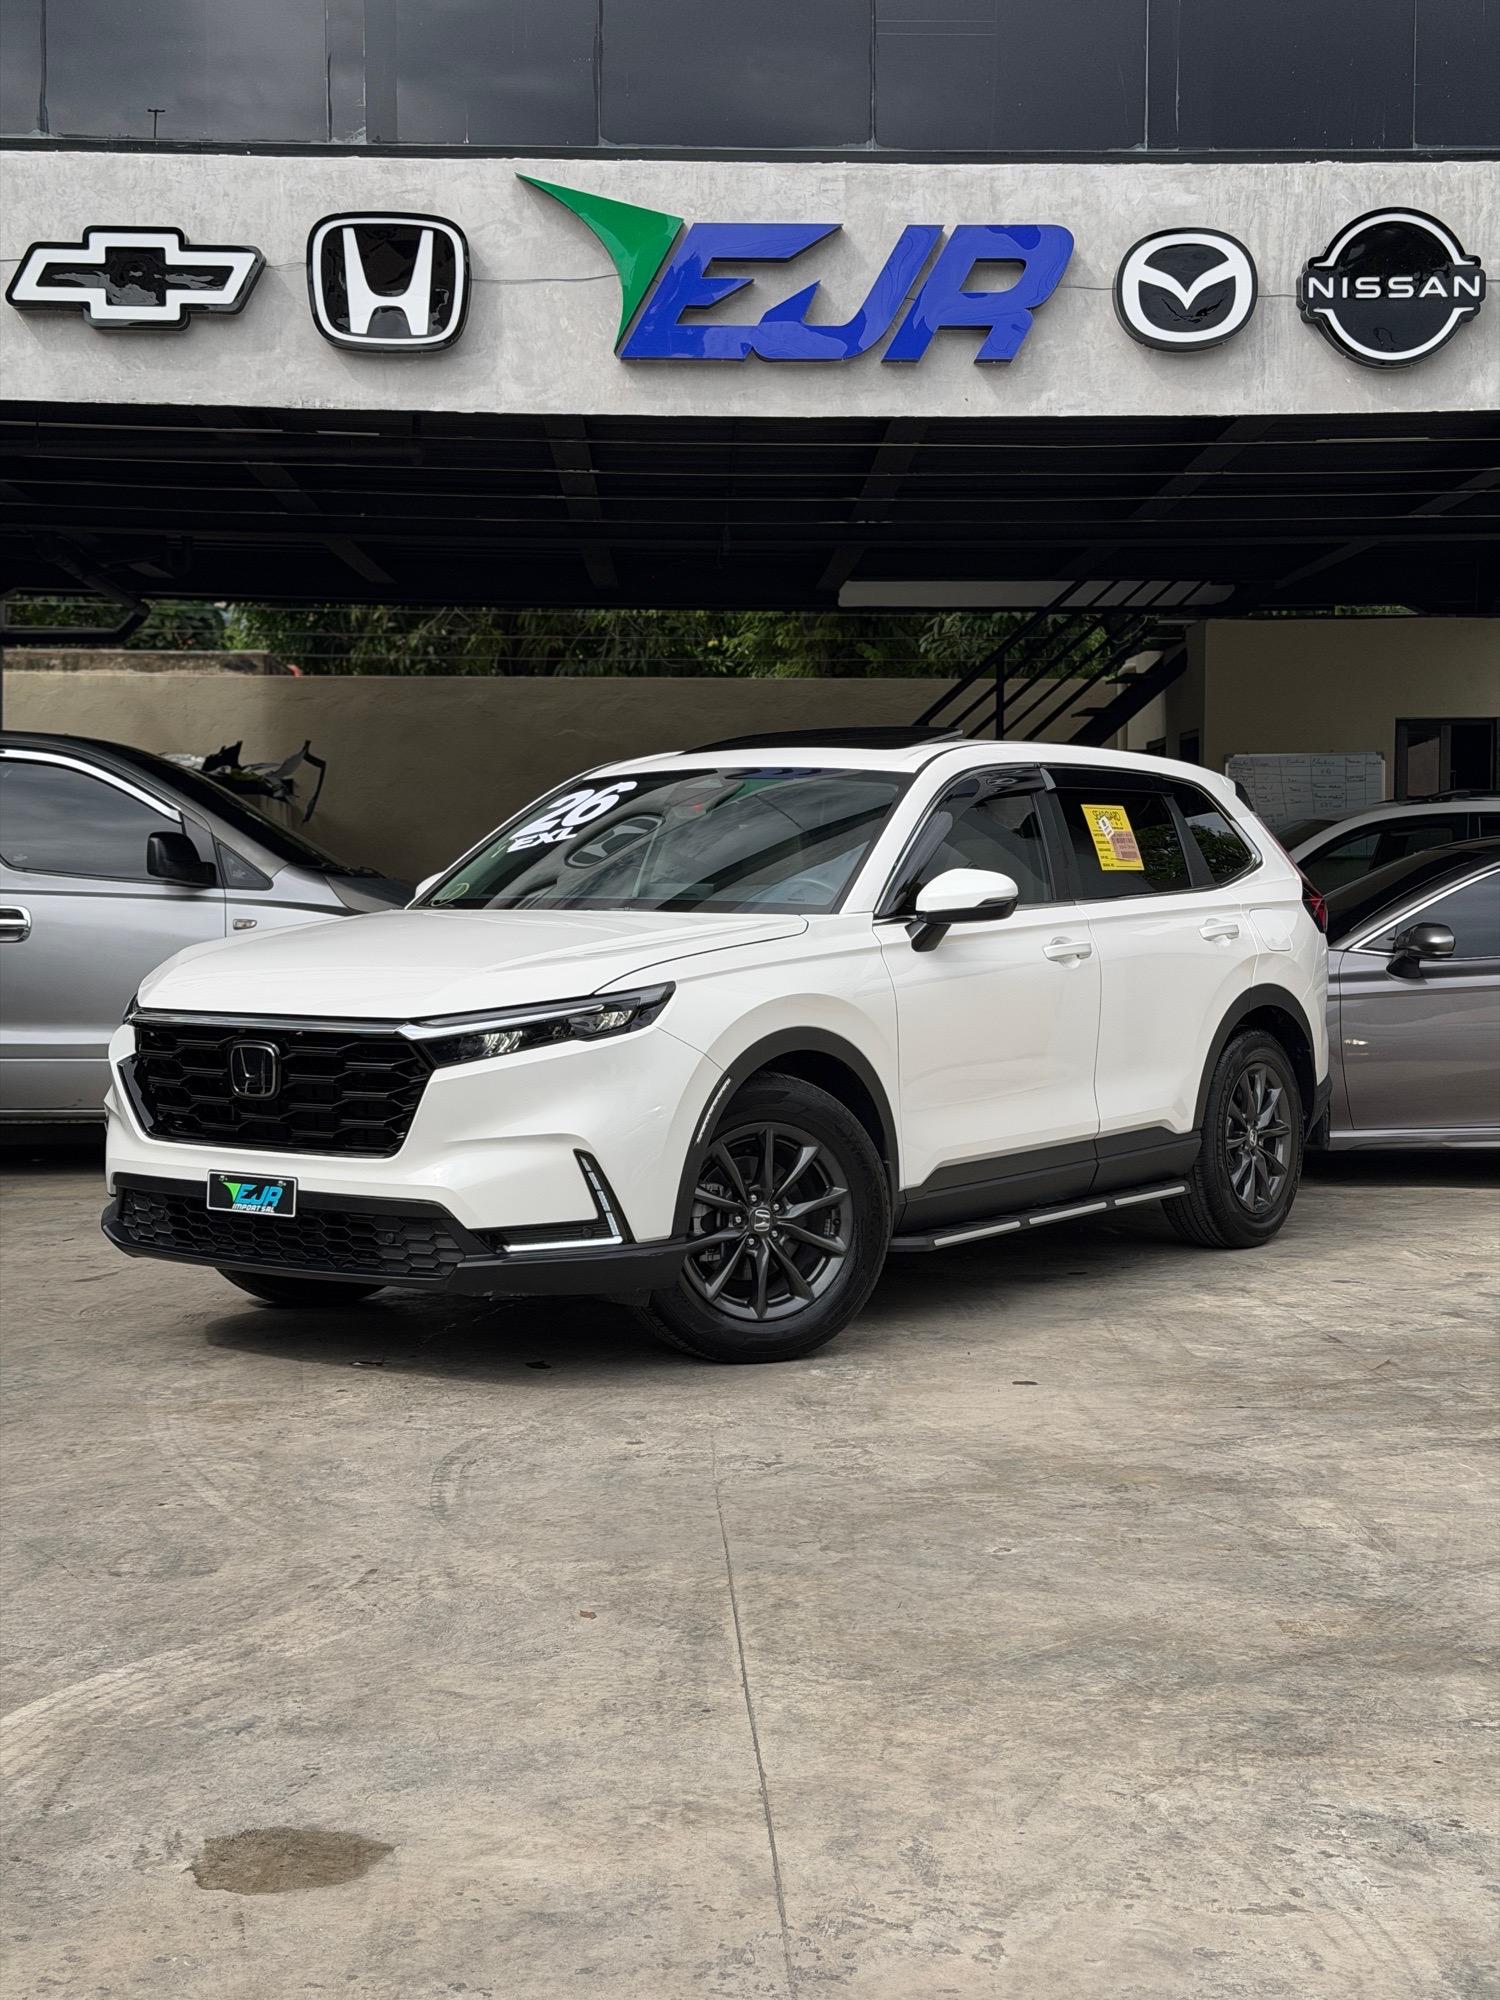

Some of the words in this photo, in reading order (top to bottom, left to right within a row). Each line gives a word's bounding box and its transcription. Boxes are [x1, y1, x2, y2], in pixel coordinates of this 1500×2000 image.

[619, 222, 1075, 364] EJR
[1307, 274, 1482, 300] NISSAN
[509, 780, 638, 840] 26
[506, 827, 578, 853] EXL
[234, 1184, 283, 1207] EJR
